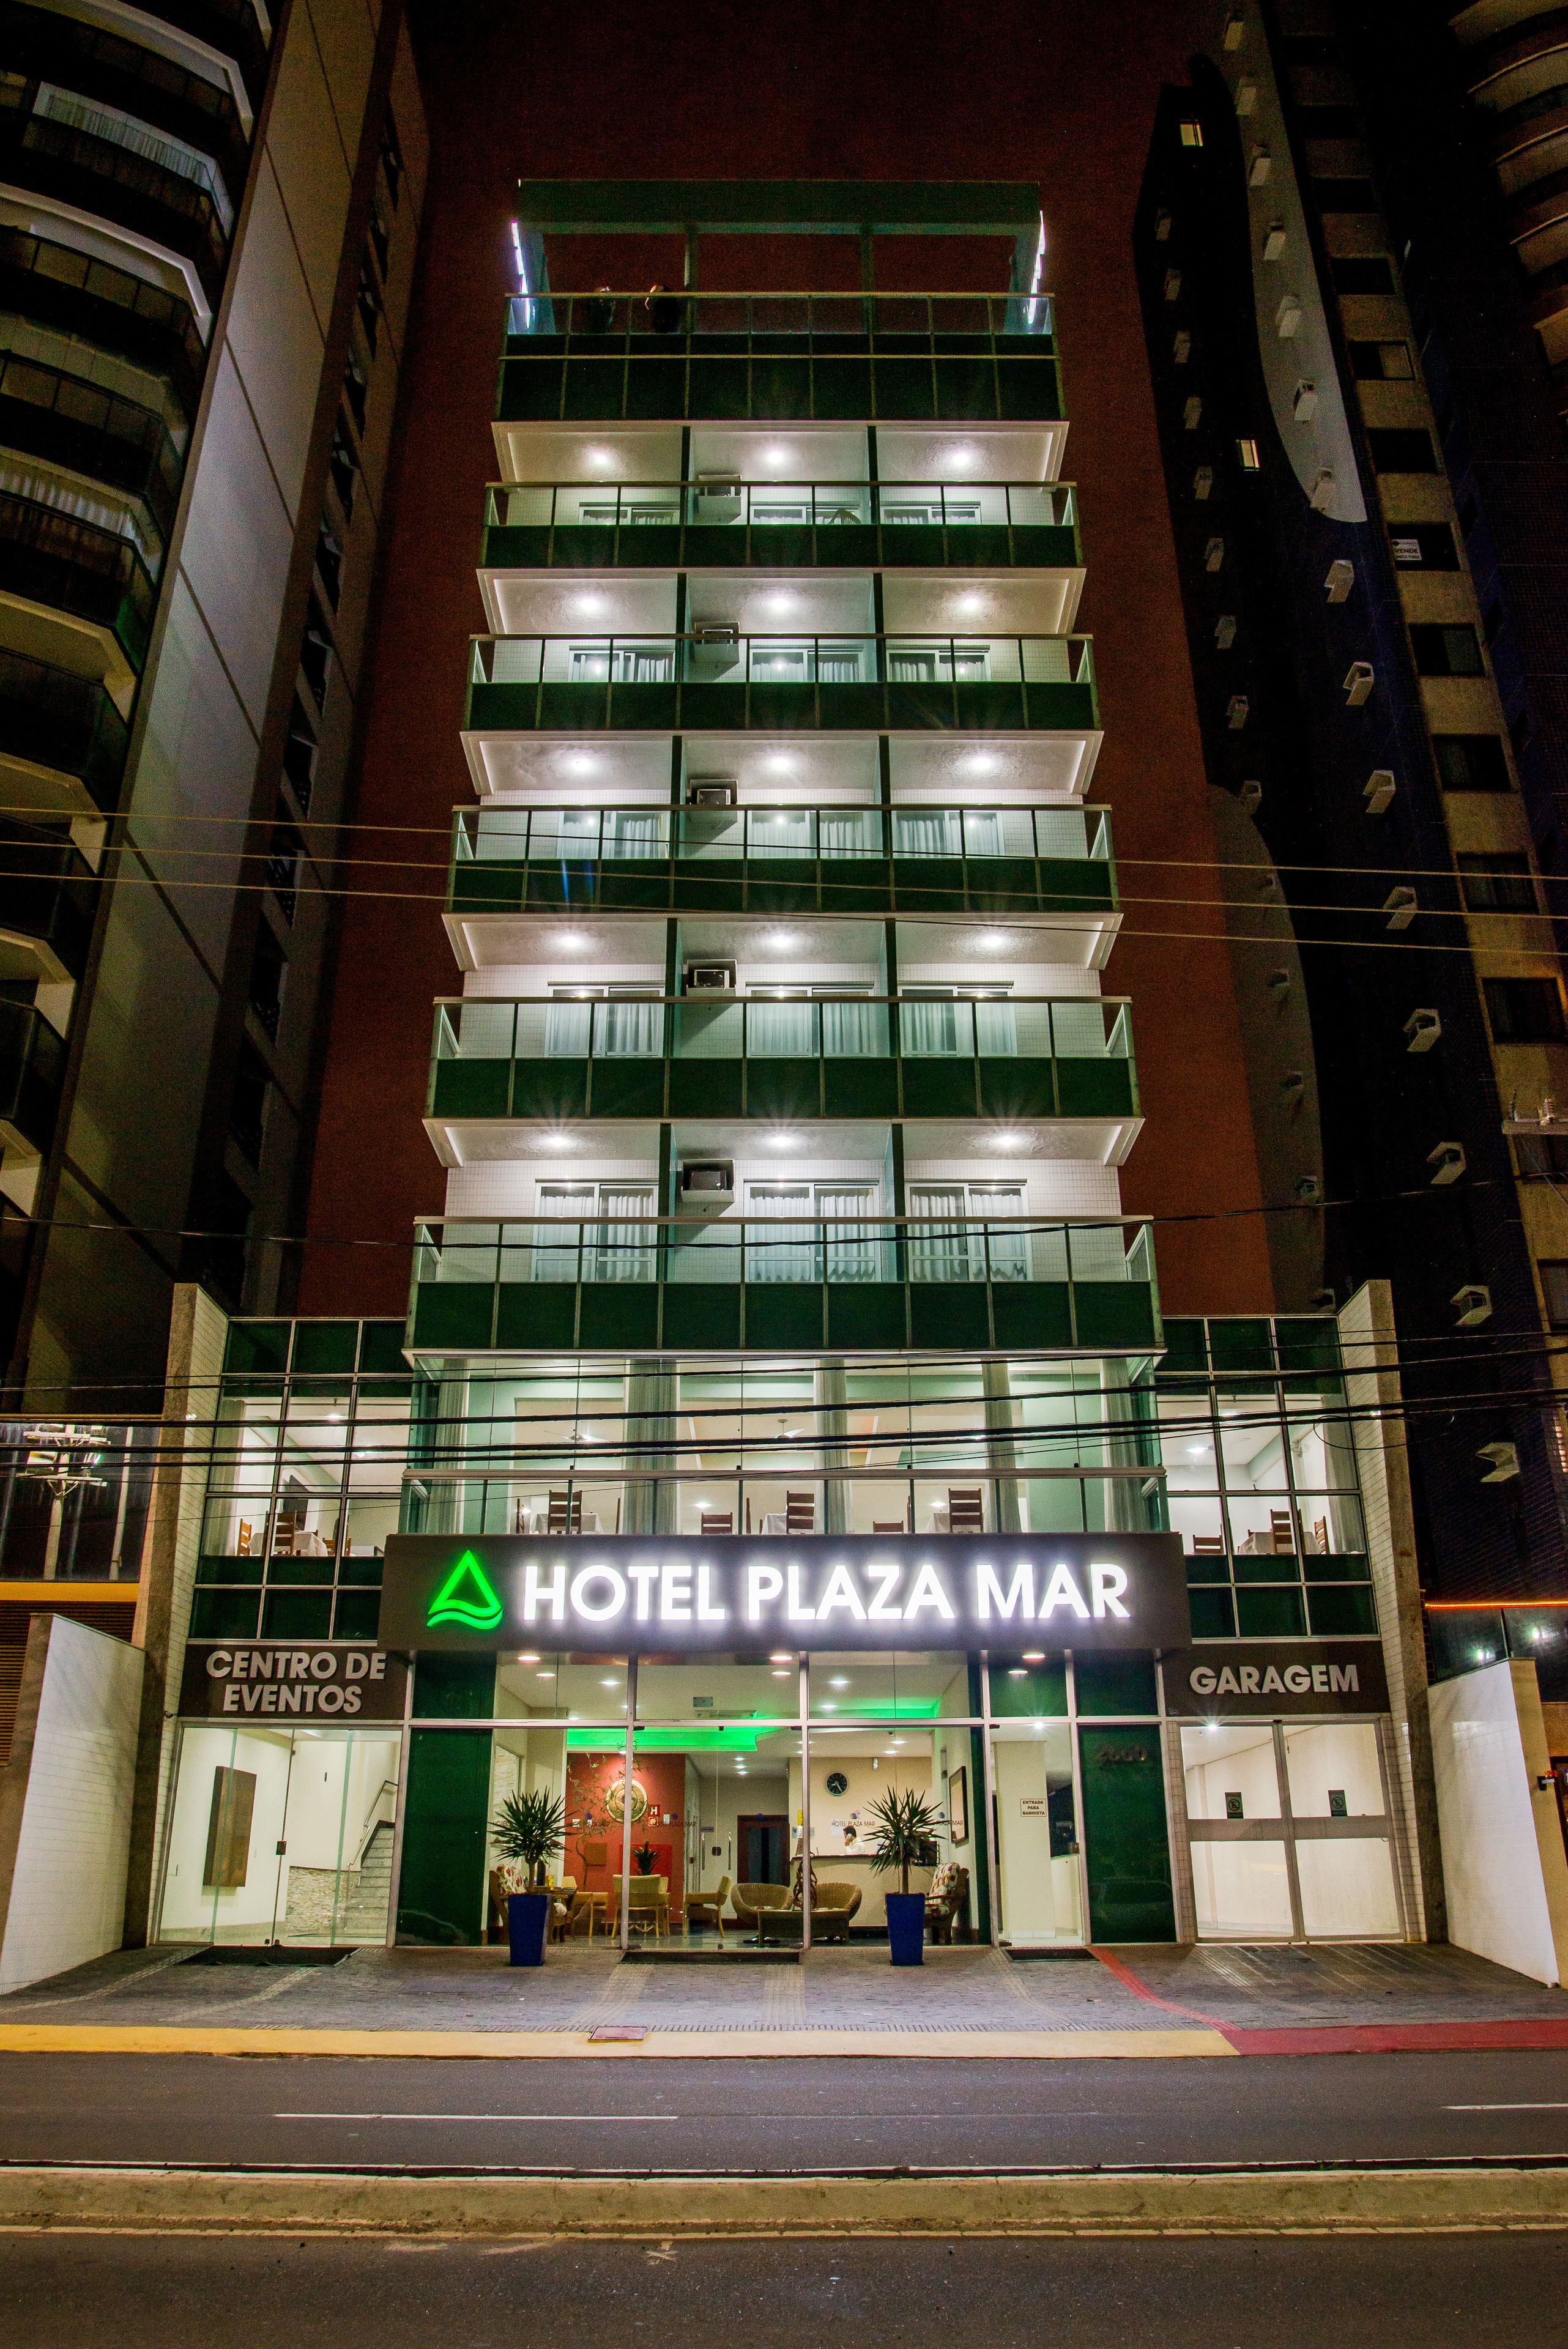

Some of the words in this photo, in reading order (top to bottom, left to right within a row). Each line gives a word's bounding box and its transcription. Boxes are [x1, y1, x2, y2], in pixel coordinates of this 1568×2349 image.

[523, 1564, 726, 1621] HOTEL
[748, 1564, 956, 1620] PLAZA
[976, 1563, 1131, 1619] MAR
[206, 1650, 337, 1679] CENTRO
[345, 1652, 387, 1680] DE
[1189, 1664, 1360, 1694] GARAGEM
[223, 1683, 362, 1713] EVENTOS
[650, 1806, 658, 1815] H
